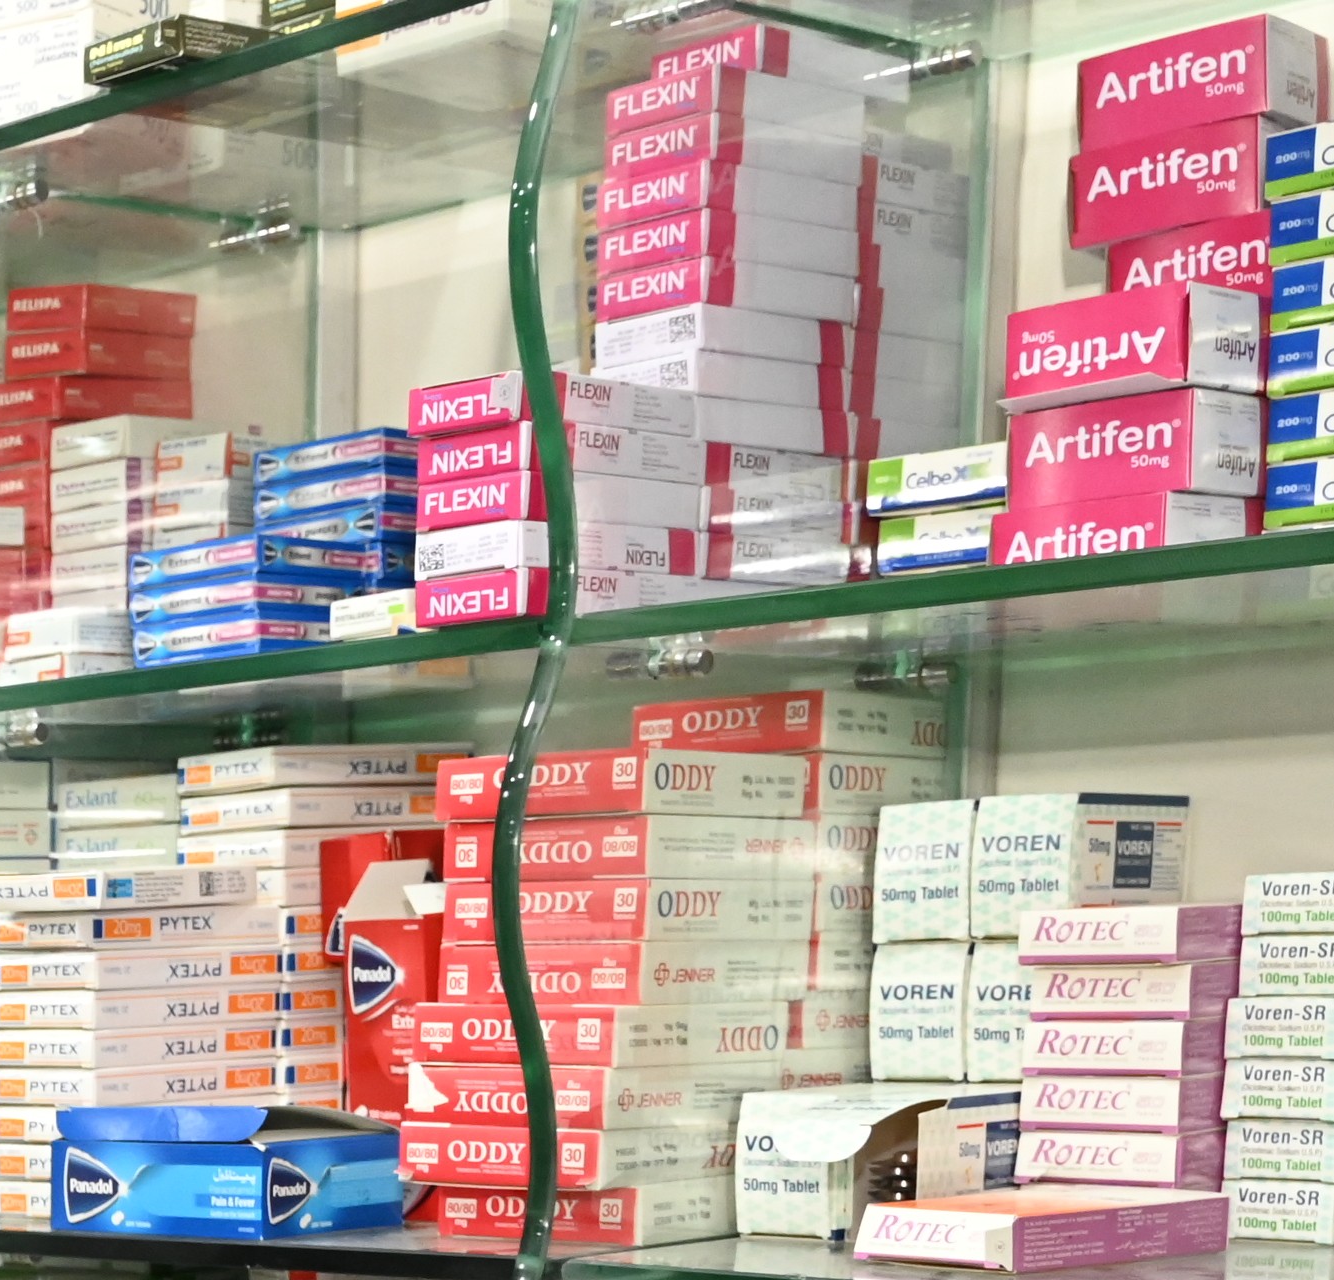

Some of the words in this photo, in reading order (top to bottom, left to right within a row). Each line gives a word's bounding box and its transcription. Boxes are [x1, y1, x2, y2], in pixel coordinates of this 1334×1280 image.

[1096, 47, 1246, 110] Artifen
[1205, 81, 1244, 97] 50mg
[613, 78, 699, 120] FLEXIN
[1087, 146, 1238, 203] Artifen
[604, 173, 688, 213] FLEXIN
[603, 269, 688, 306] FLEXIN
[13, 297, 61, 312] RELISPA
[1022, 332, 1055, 343] 50mg
[1019, 327, 1166, 377] Artifen
[1025, 421, 1173, 468] Artifen
[1131, 455, 1169, 469] 50mg
[425, 483, 509, 516] FLEXIN
[430, 588, 509, 618] FLEXIN
[681, 708, 763, 734] ODDY
[788, 705, 806, 720] 30
[215, 760, 260, 776] PYTEX
[655, 763, 716, 793] ODDY
[66, 788, 118, 810] Exlant
[884, 843, 960, 861] VOREN
[881, 887, 916, 902] 50mg
[920, 884, 959, 900] Tablet
[113, 920, 142, 936] 20mg
[159, 916, 212, 931] PYTEX
[354, 967, 391, 982] Panadol
[672, 967, 716, 983] JENNER
[880, 984, 955, 1000] VOREN
[29, 1003, 79, 1017] PYTEX
[1244, 1005, 1326, 1022] Voren-SR
[421, 1025, 452, 1040] 80/80
[717, 1026, 779, 1050] ODDY
[879, 1026, 913, 1041] 50mg
[917, 1025, 955, 1039] Tablet
[1243, 1033, 1280, 1048] 100mg
[1284, 1034, 1323, 1048] Tablet
[448, 1141, 526, 1165] ODDY
[71, 1180, 113, 1195] Panadol
[1238, 1188, 1319, 1206] Voren-SR
[1237, 1217, 1274, 1233] 100mg
[1278, 1217, 1318, 1232] Tablet
